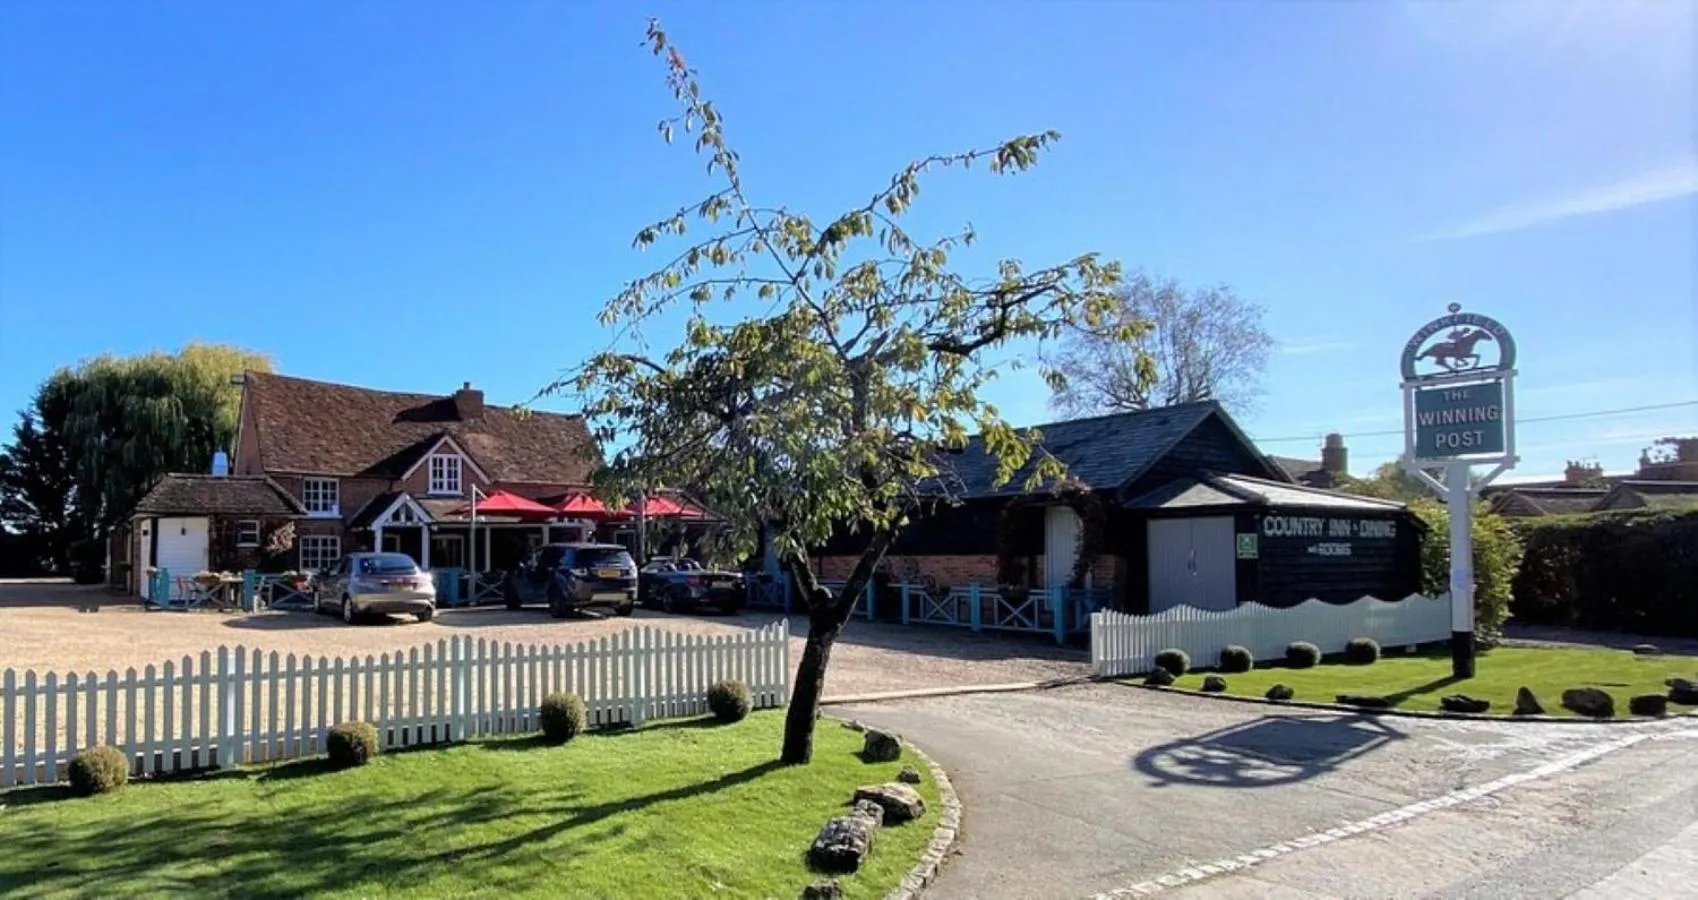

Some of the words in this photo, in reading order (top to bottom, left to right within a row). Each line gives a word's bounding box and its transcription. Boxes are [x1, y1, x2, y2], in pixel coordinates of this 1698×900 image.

[1443, 390, 1470, 401] THE
[1418, 405, 1499, 426] WINNING
[1436, 431, 1484, 448] POST
[1263, 516, 1324, 537] COUNTRY
[1328, 518, 1351, 537] INN
[1359, 519, 1397, 538] DINING
